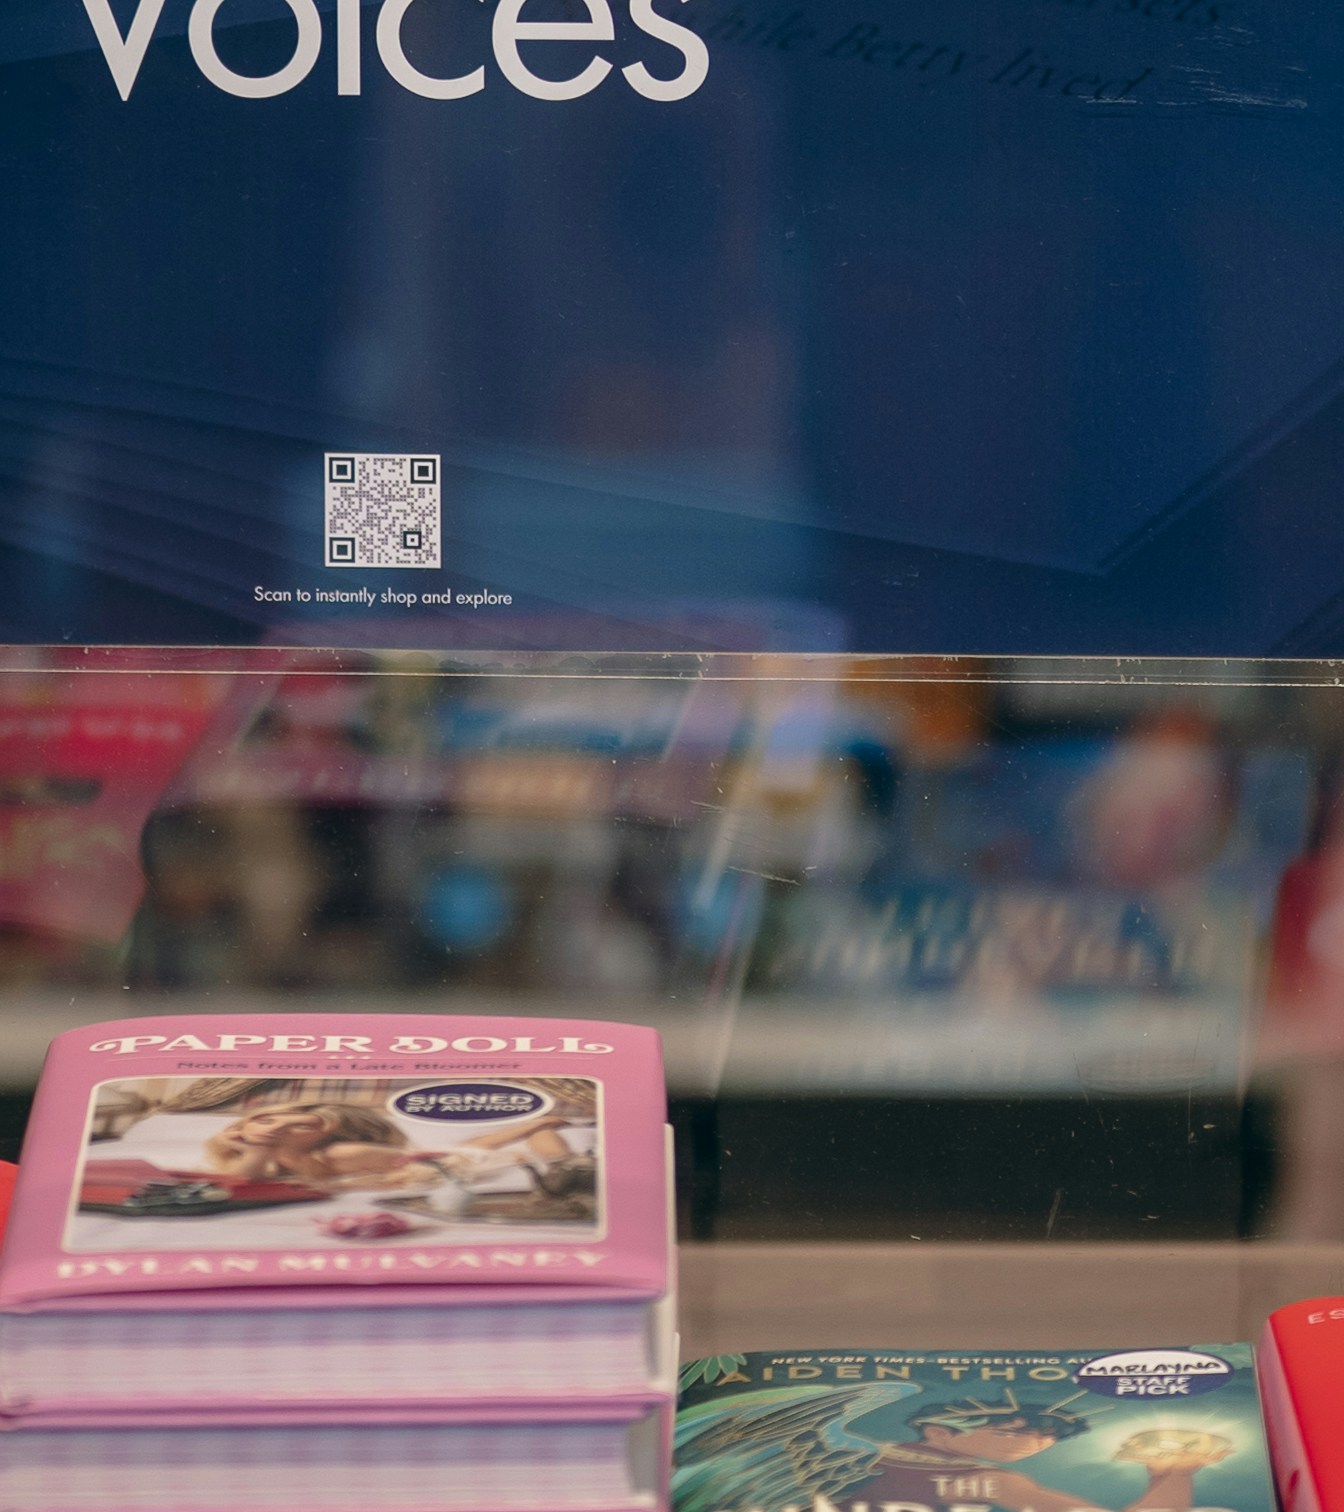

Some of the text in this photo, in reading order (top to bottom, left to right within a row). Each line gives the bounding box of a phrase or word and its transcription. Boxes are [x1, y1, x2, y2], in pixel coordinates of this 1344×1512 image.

[254, 586, 513, 609] Scan to instantly shop and explore
[89, 1033, 614, 1055] PAPER DOLL
[176, 1061, 249, 1071] Notes
[414, 1062, 522, 1072] Bloomer
[406, 1093, 536, 1106] SIGNED
[1117, 1376, 1190, 1387] STAFF
[1116, 1385, 1190, 1396] PICK
[931, 1476, 998, 1500] THE
